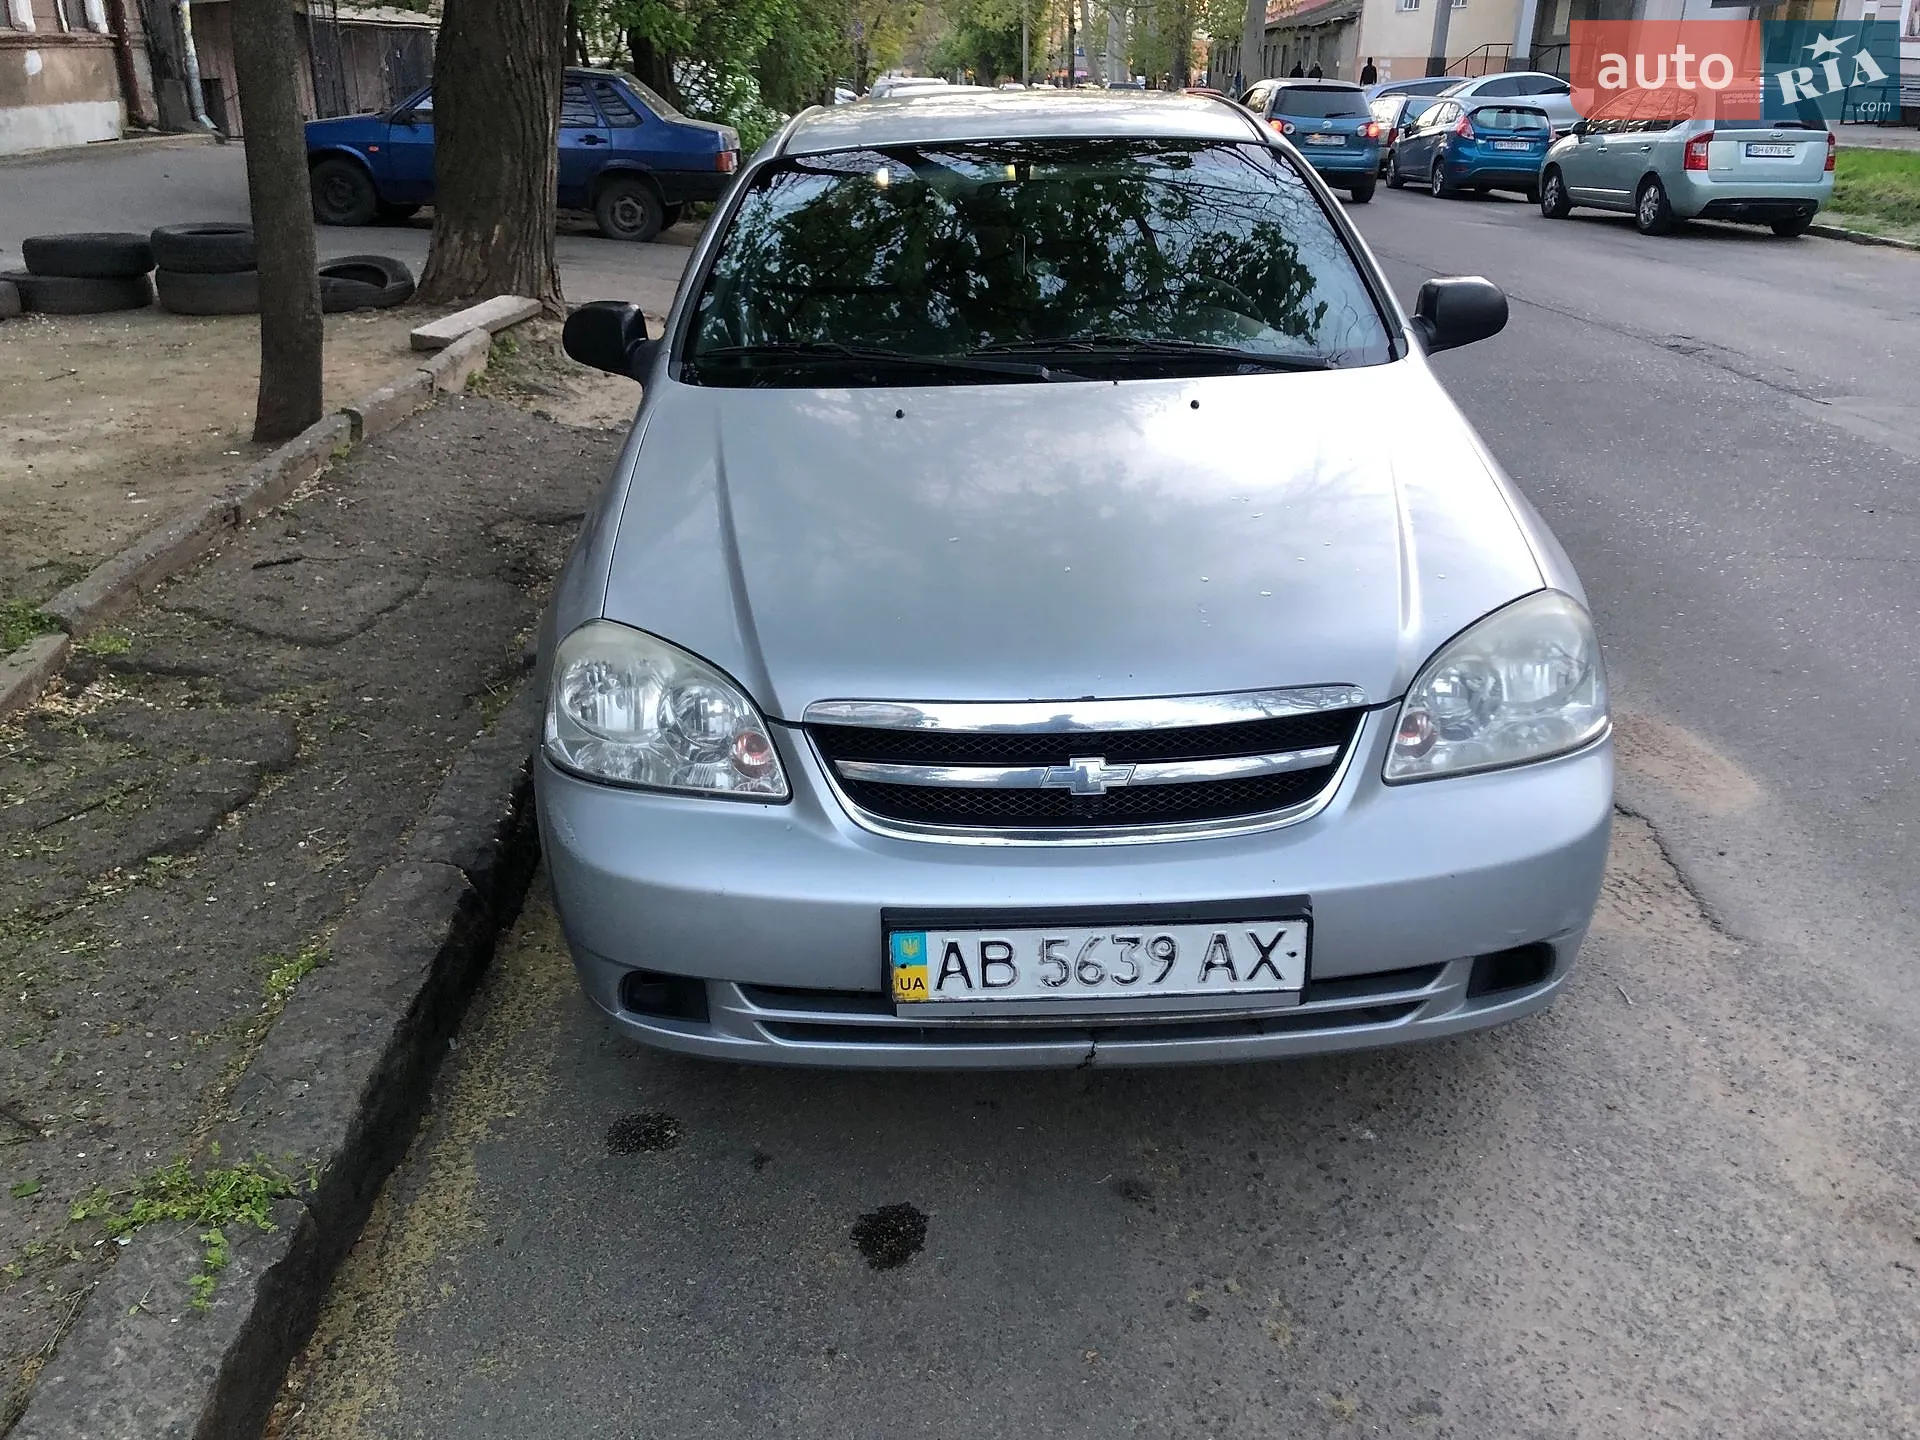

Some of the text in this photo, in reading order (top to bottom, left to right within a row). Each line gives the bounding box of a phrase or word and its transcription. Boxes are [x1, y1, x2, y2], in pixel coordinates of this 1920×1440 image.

[935, 929, 1288, 991] AB 5639 AX
[899, 977, 926, 991] UA
